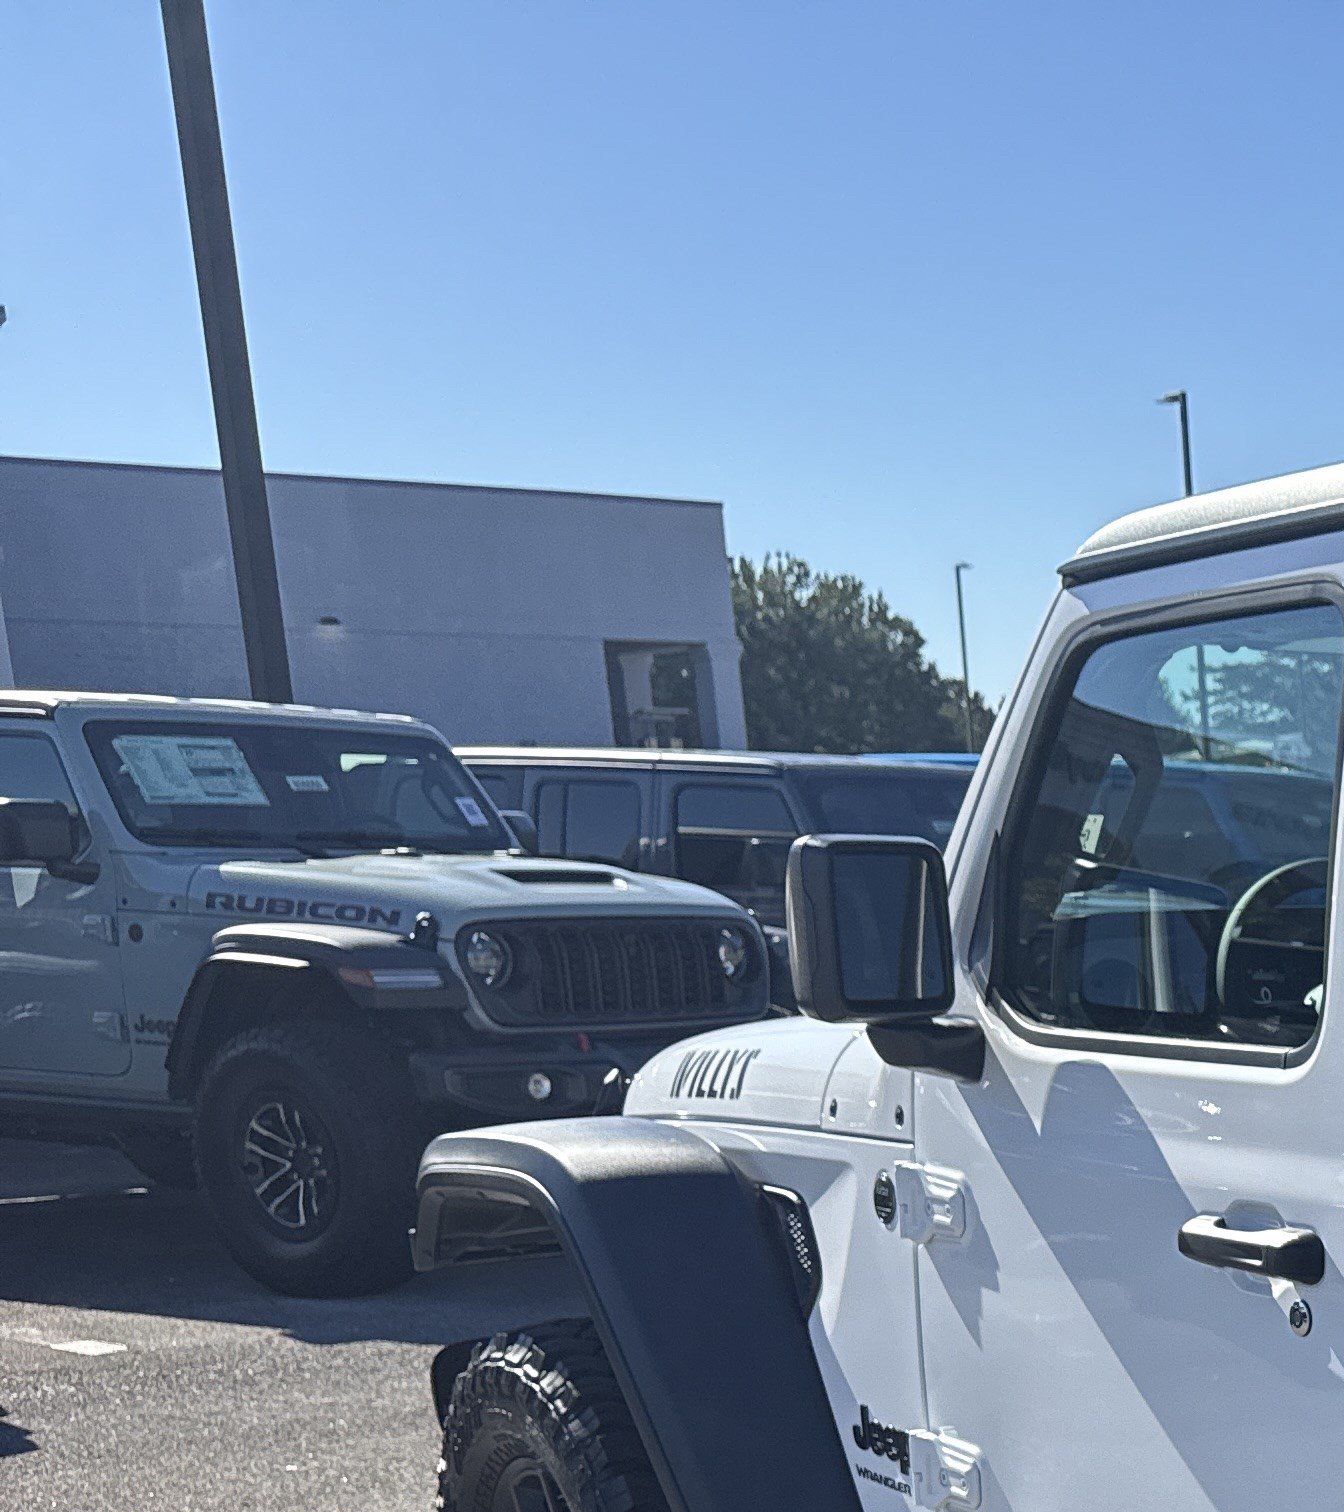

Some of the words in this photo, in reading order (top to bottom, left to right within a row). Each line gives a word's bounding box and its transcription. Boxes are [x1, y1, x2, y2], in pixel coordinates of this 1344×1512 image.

[205, 891, 400, 926] RUBICON
[669, 1047, 762, 1100] WILLYS
[852, 1404, 911, 1476] Jeep
[855, 1462, 912, 1497] WRANGLER
